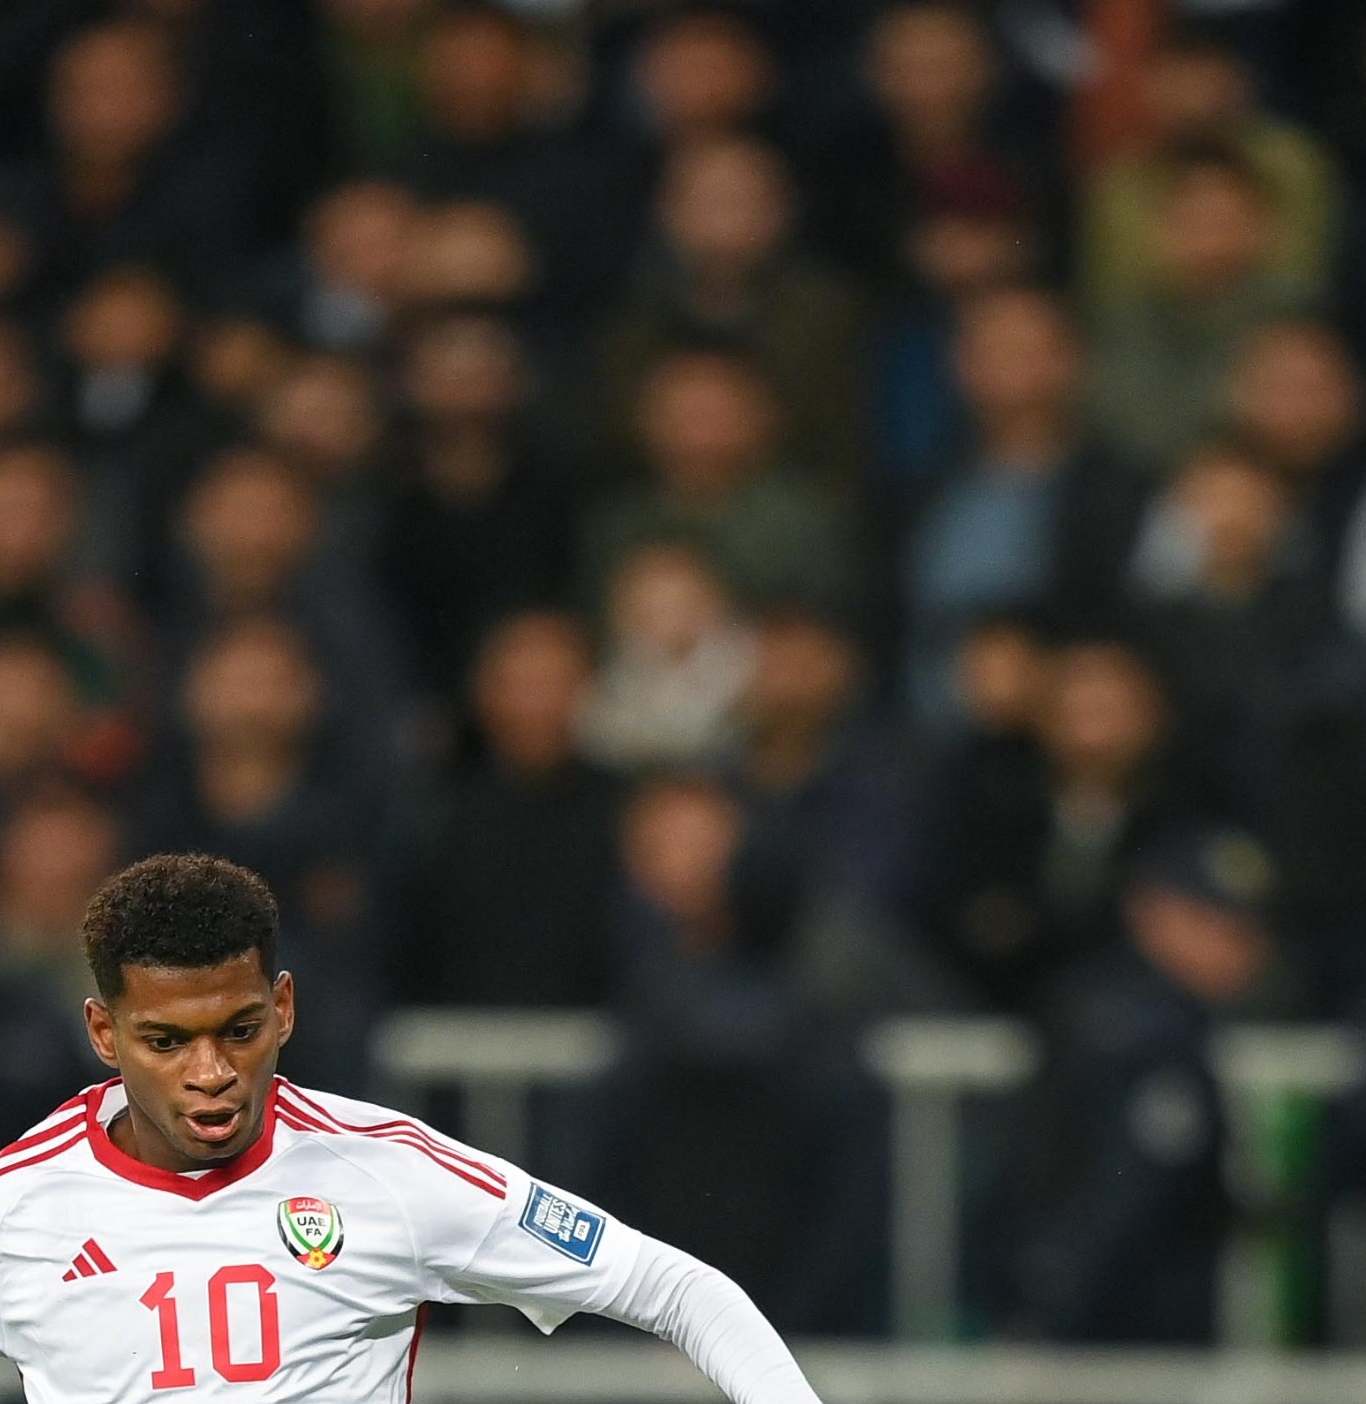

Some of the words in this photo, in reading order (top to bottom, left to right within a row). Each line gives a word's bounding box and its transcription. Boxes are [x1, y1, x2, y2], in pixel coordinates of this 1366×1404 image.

[297, 1216, 326, 1227] UAE
[543, 1198, 567, 1234] UNITES
[305, 1228, 323, 1237] FA
[139, 1264, 281, 1390] 10
